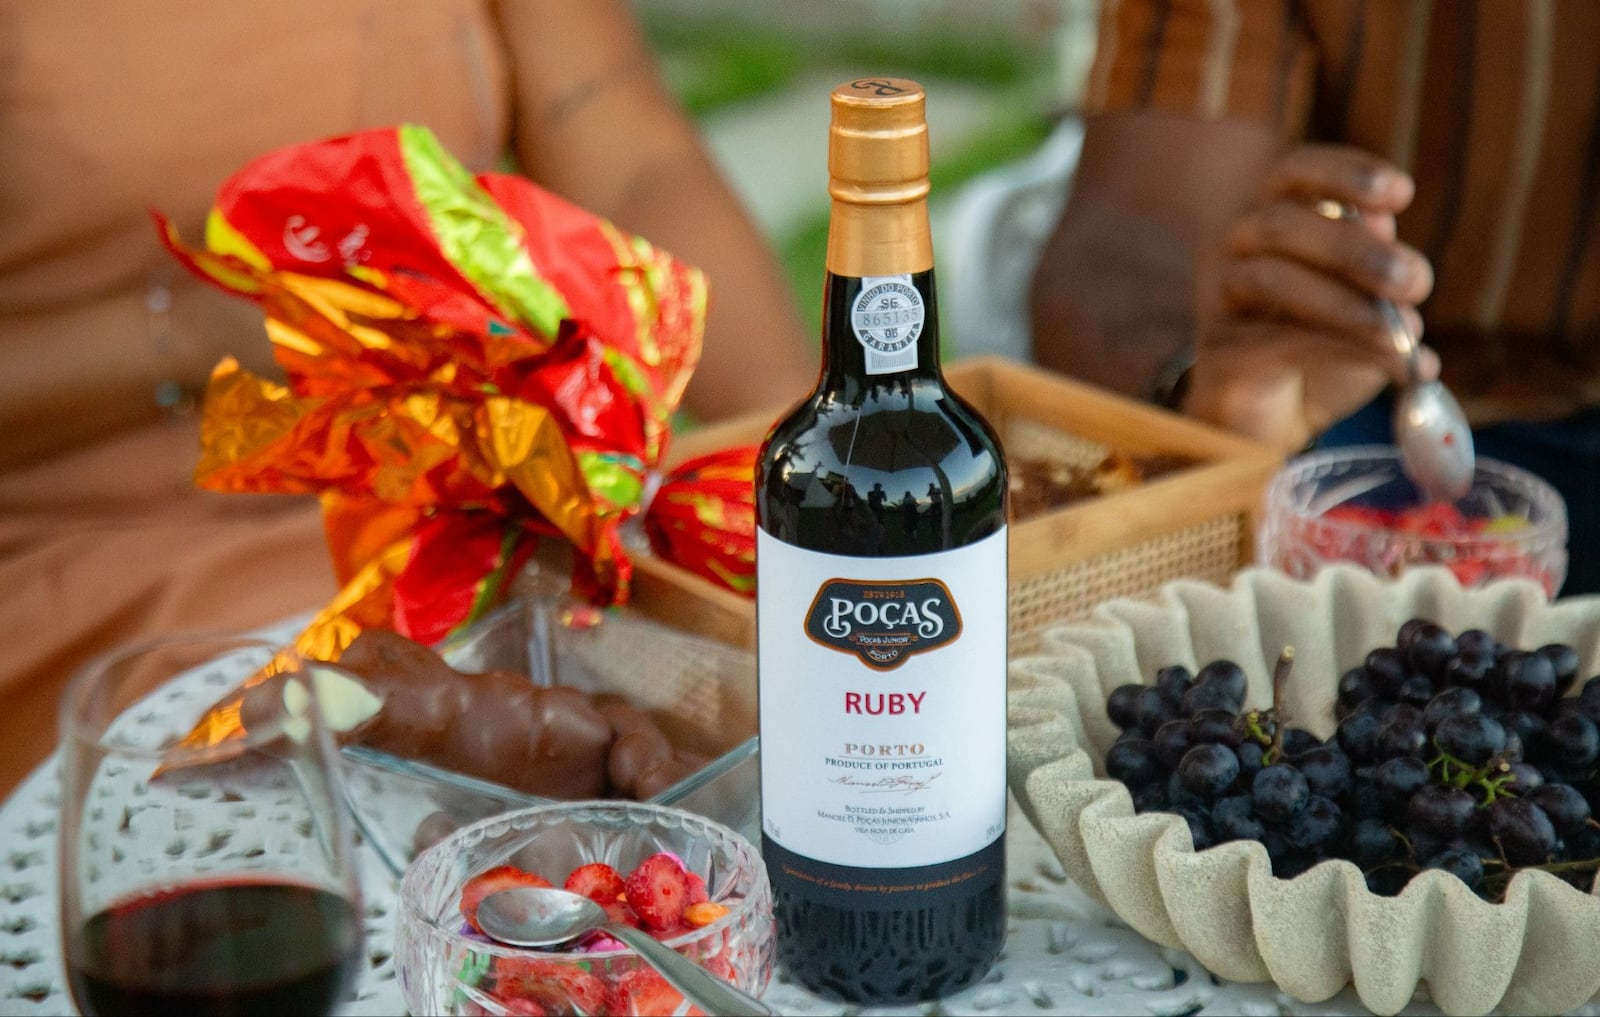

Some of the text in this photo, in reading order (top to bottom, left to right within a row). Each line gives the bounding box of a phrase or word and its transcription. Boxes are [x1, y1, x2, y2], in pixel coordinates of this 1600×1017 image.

[880, 298, 899, 309] SE
[881, 284, 895, 293] DO
[897, 284, 920, 306] PORTO
[863, 309, 918, 326] 865135
[863, 325, 920, 351] GARANTIA
[824, 598, 944, 639] POÇAS
[870, 650, 898, 660] PORTO
[845, 691, 927, 715] RUBY
[844, 743, 925, 756] PORTO
[825, 757, 944, 770] PRODUCE OF PORTUGAL
